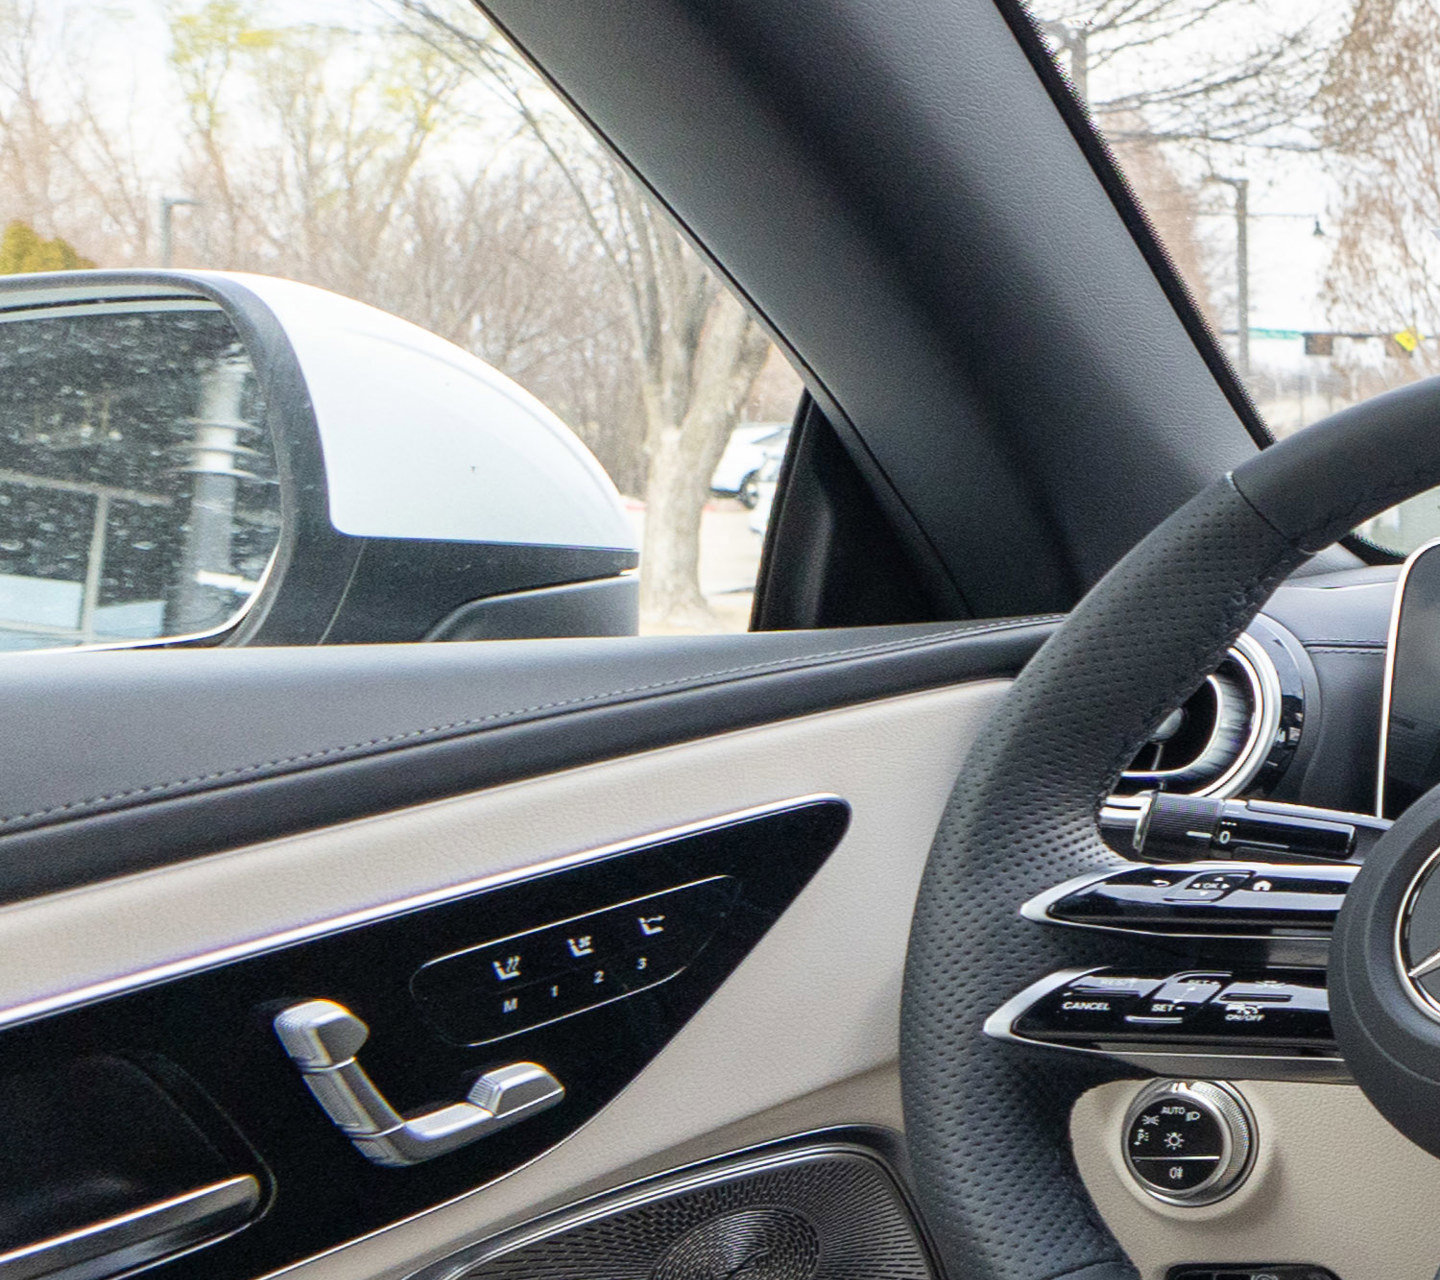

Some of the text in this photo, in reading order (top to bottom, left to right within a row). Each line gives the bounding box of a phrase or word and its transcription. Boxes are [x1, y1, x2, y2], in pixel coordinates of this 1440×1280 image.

[637, 957, 648, 970] 3
[593, 970, 604, 984] 2
[551, 984, 559, 998] 1
[503, 997, 518, 1014] M
[1061, 1001, 1111, 1012] CANCEL
[1151, 1003, 1174, 1013] SET
[1161, 1106, 1186, 1115] AUTO
